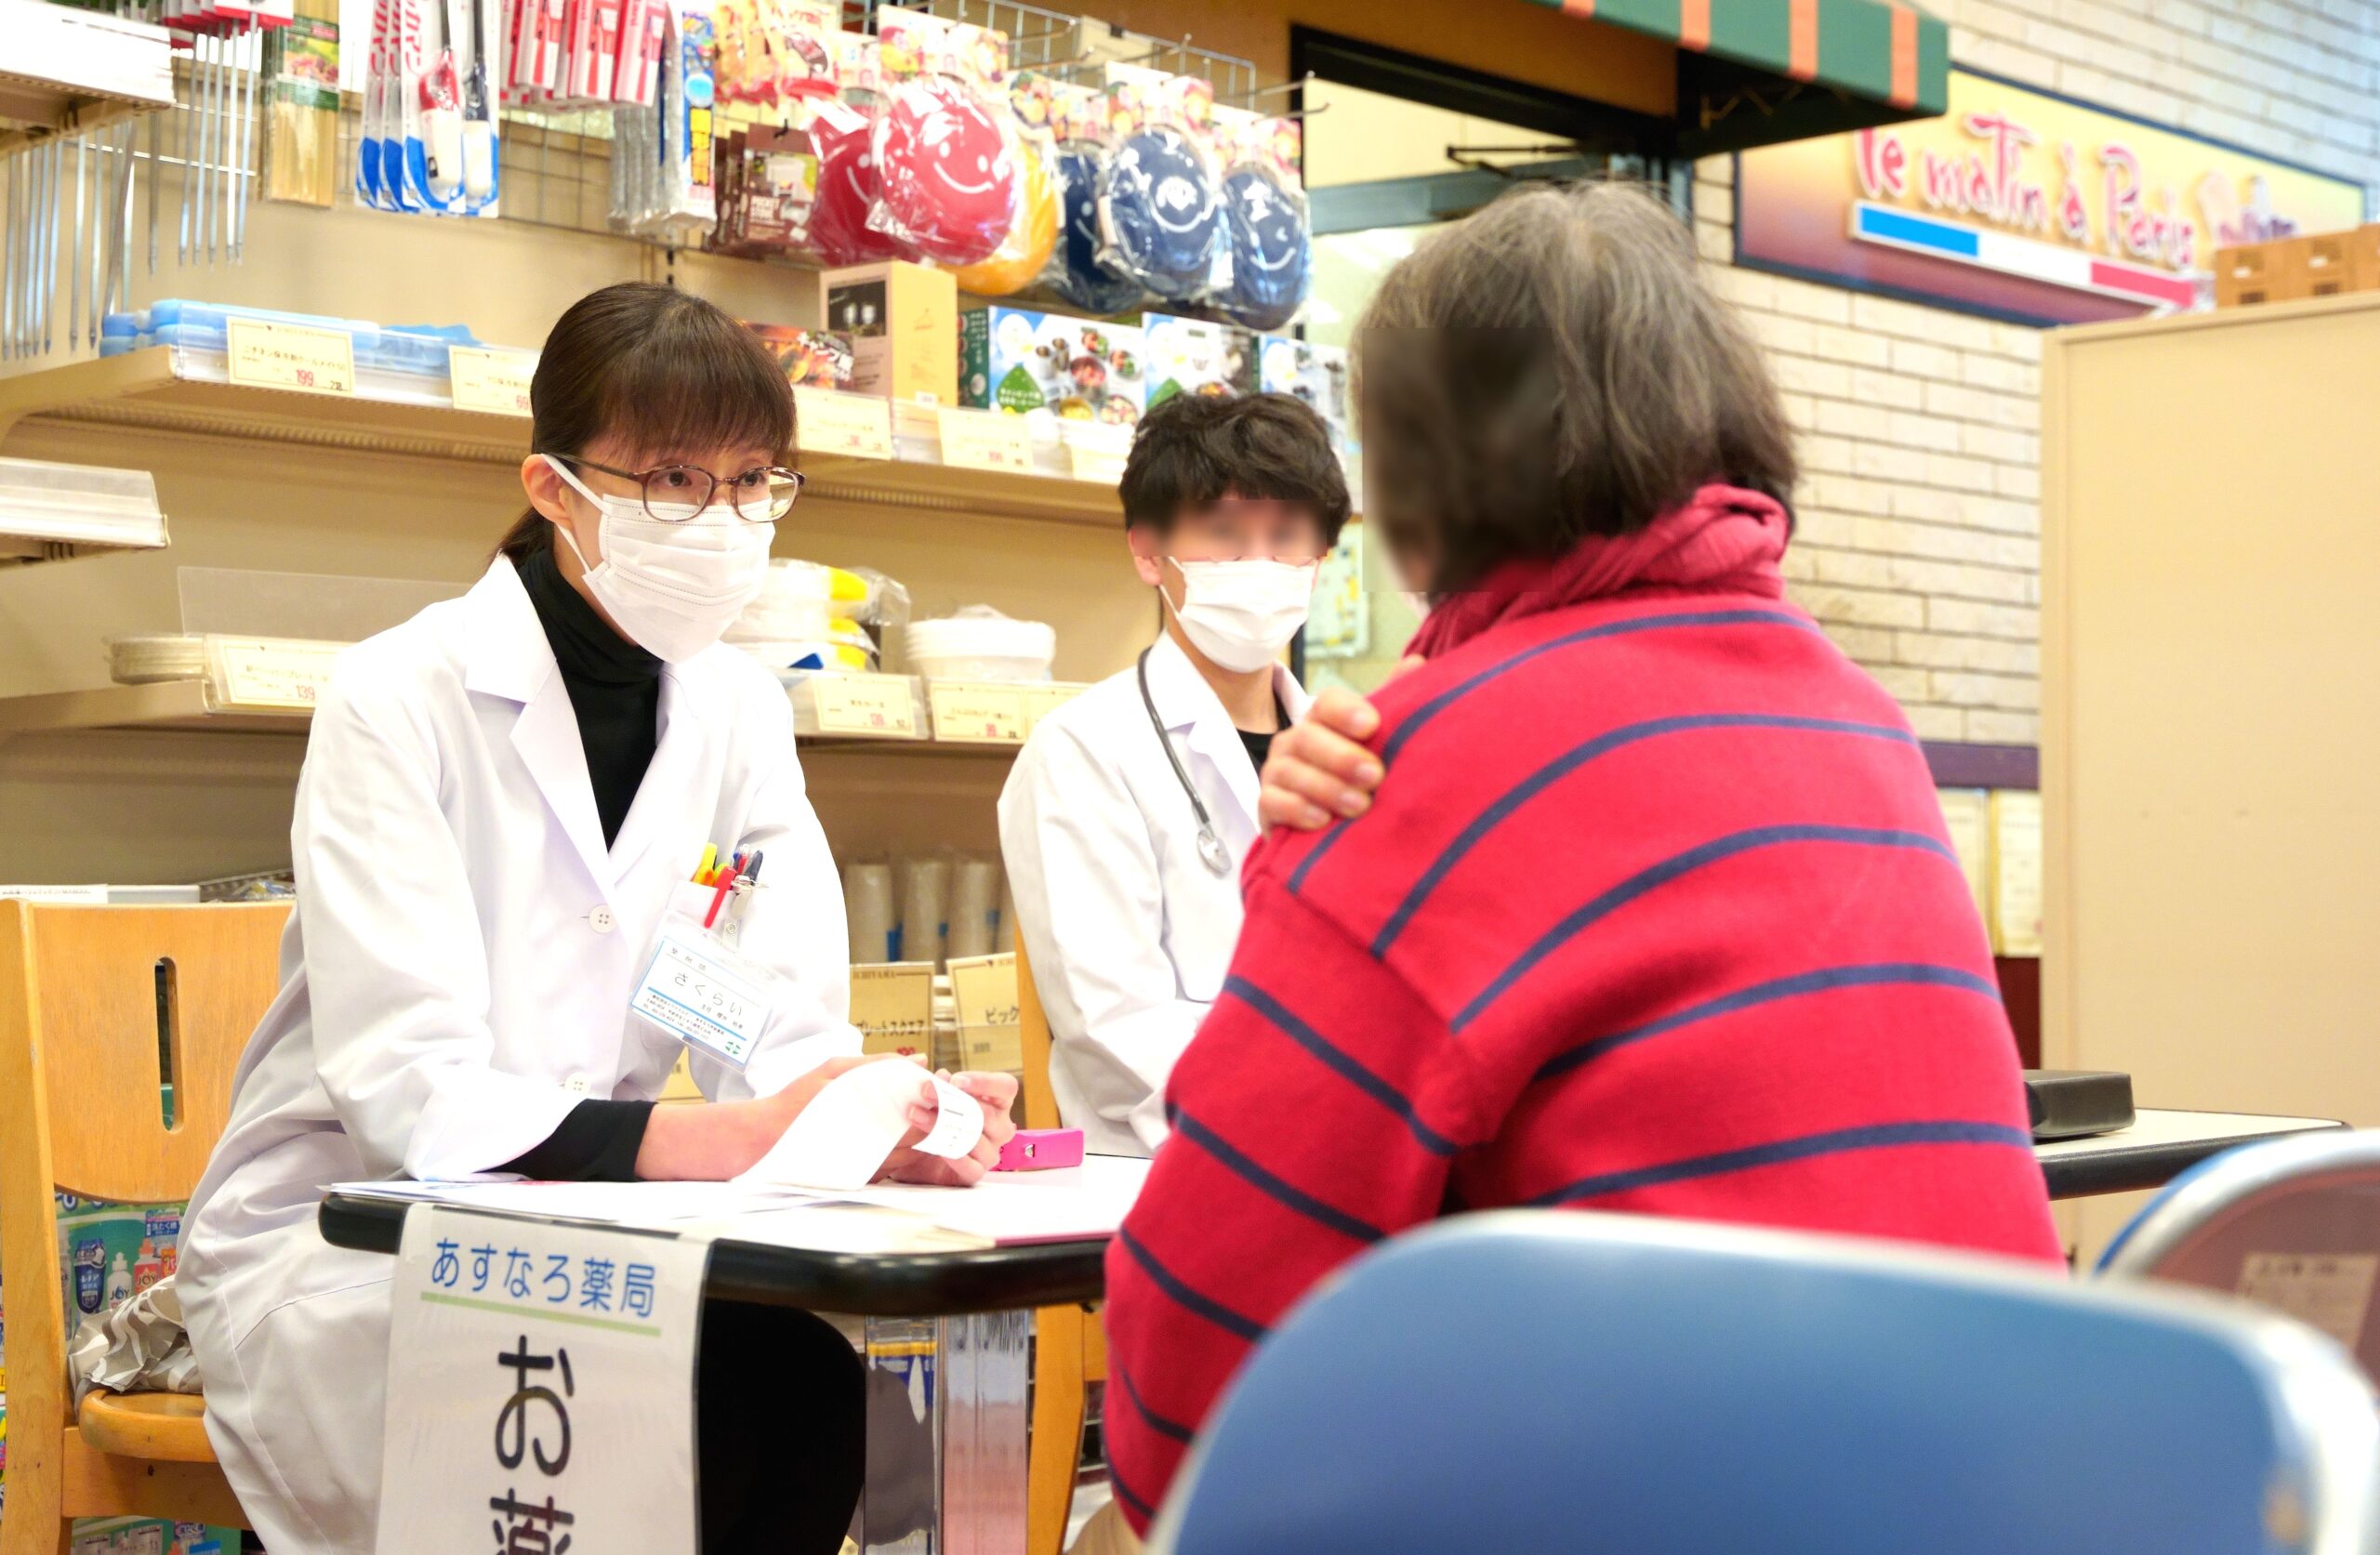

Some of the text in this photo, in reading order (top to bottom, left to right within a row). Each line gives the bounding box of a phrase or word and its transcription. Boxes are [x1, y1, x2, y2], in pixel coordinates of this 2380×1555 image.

[2098, 145, 2197, 268] Paris
[297, 369, 313, 387] 199
[296, 684, 315, 700] 139
[674, 972, 743, 1016] さくらい
[139, 1272, 156, 1285] JOY
[431, 1237, 655, 1318] あすなろ薬局
[110, 1286, 129, 1300] JOY
